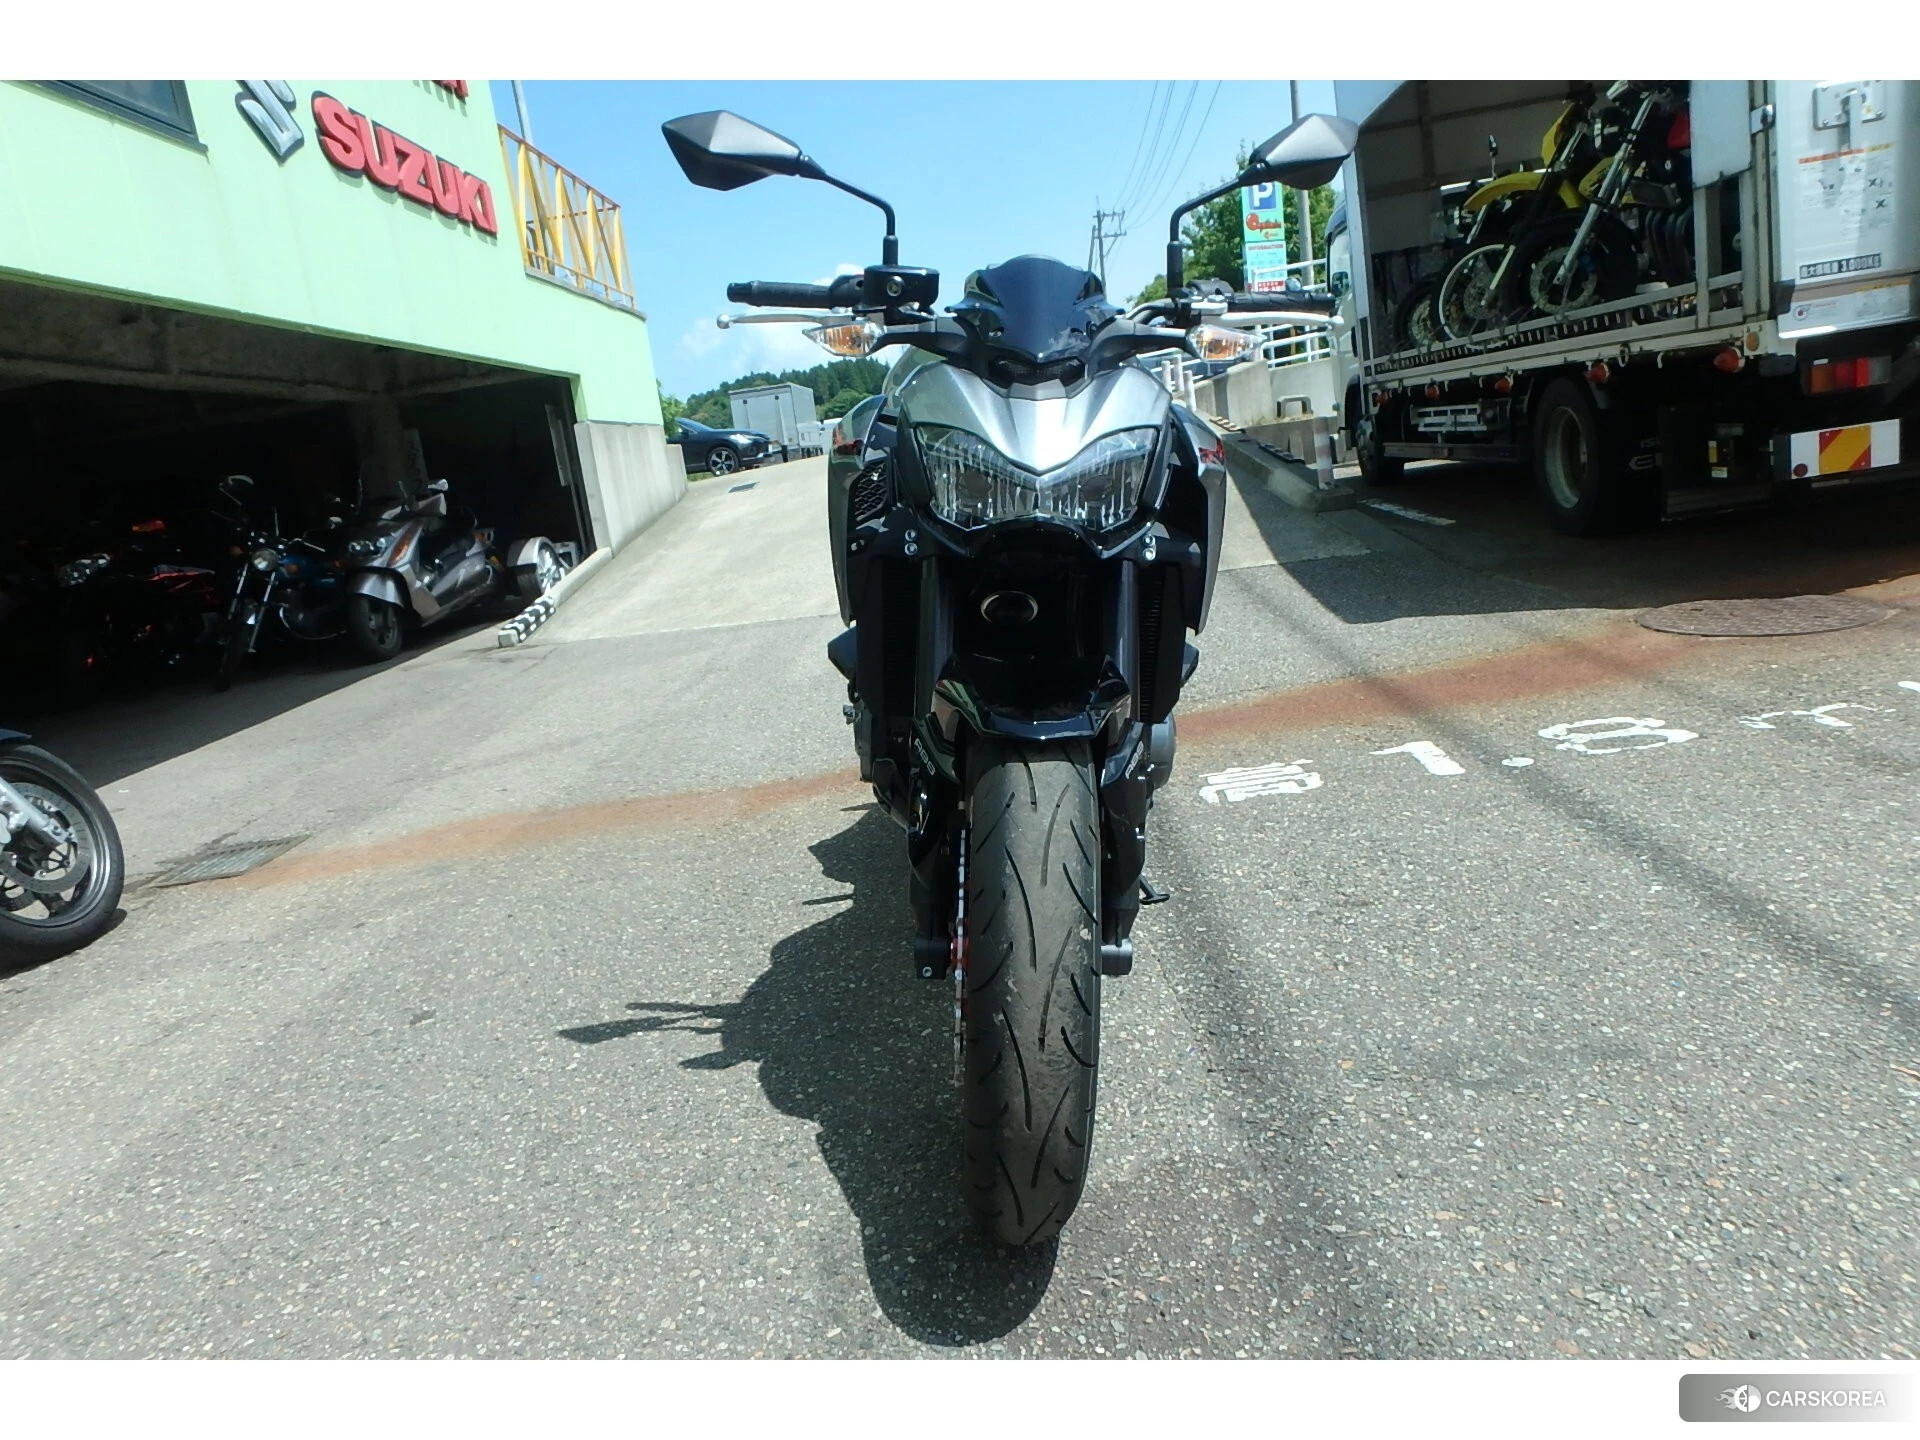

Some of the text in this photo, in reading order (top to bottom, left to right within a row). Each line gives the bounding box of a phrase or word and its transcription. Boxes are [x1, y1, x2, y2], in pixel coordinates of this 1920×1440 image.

[313, 92, 498, 234] SUZUKI
[1252, 182, 1273, 207] P
[914, 738, 936, 776] ABS
[1125, 741, 1144, 779] ABS
